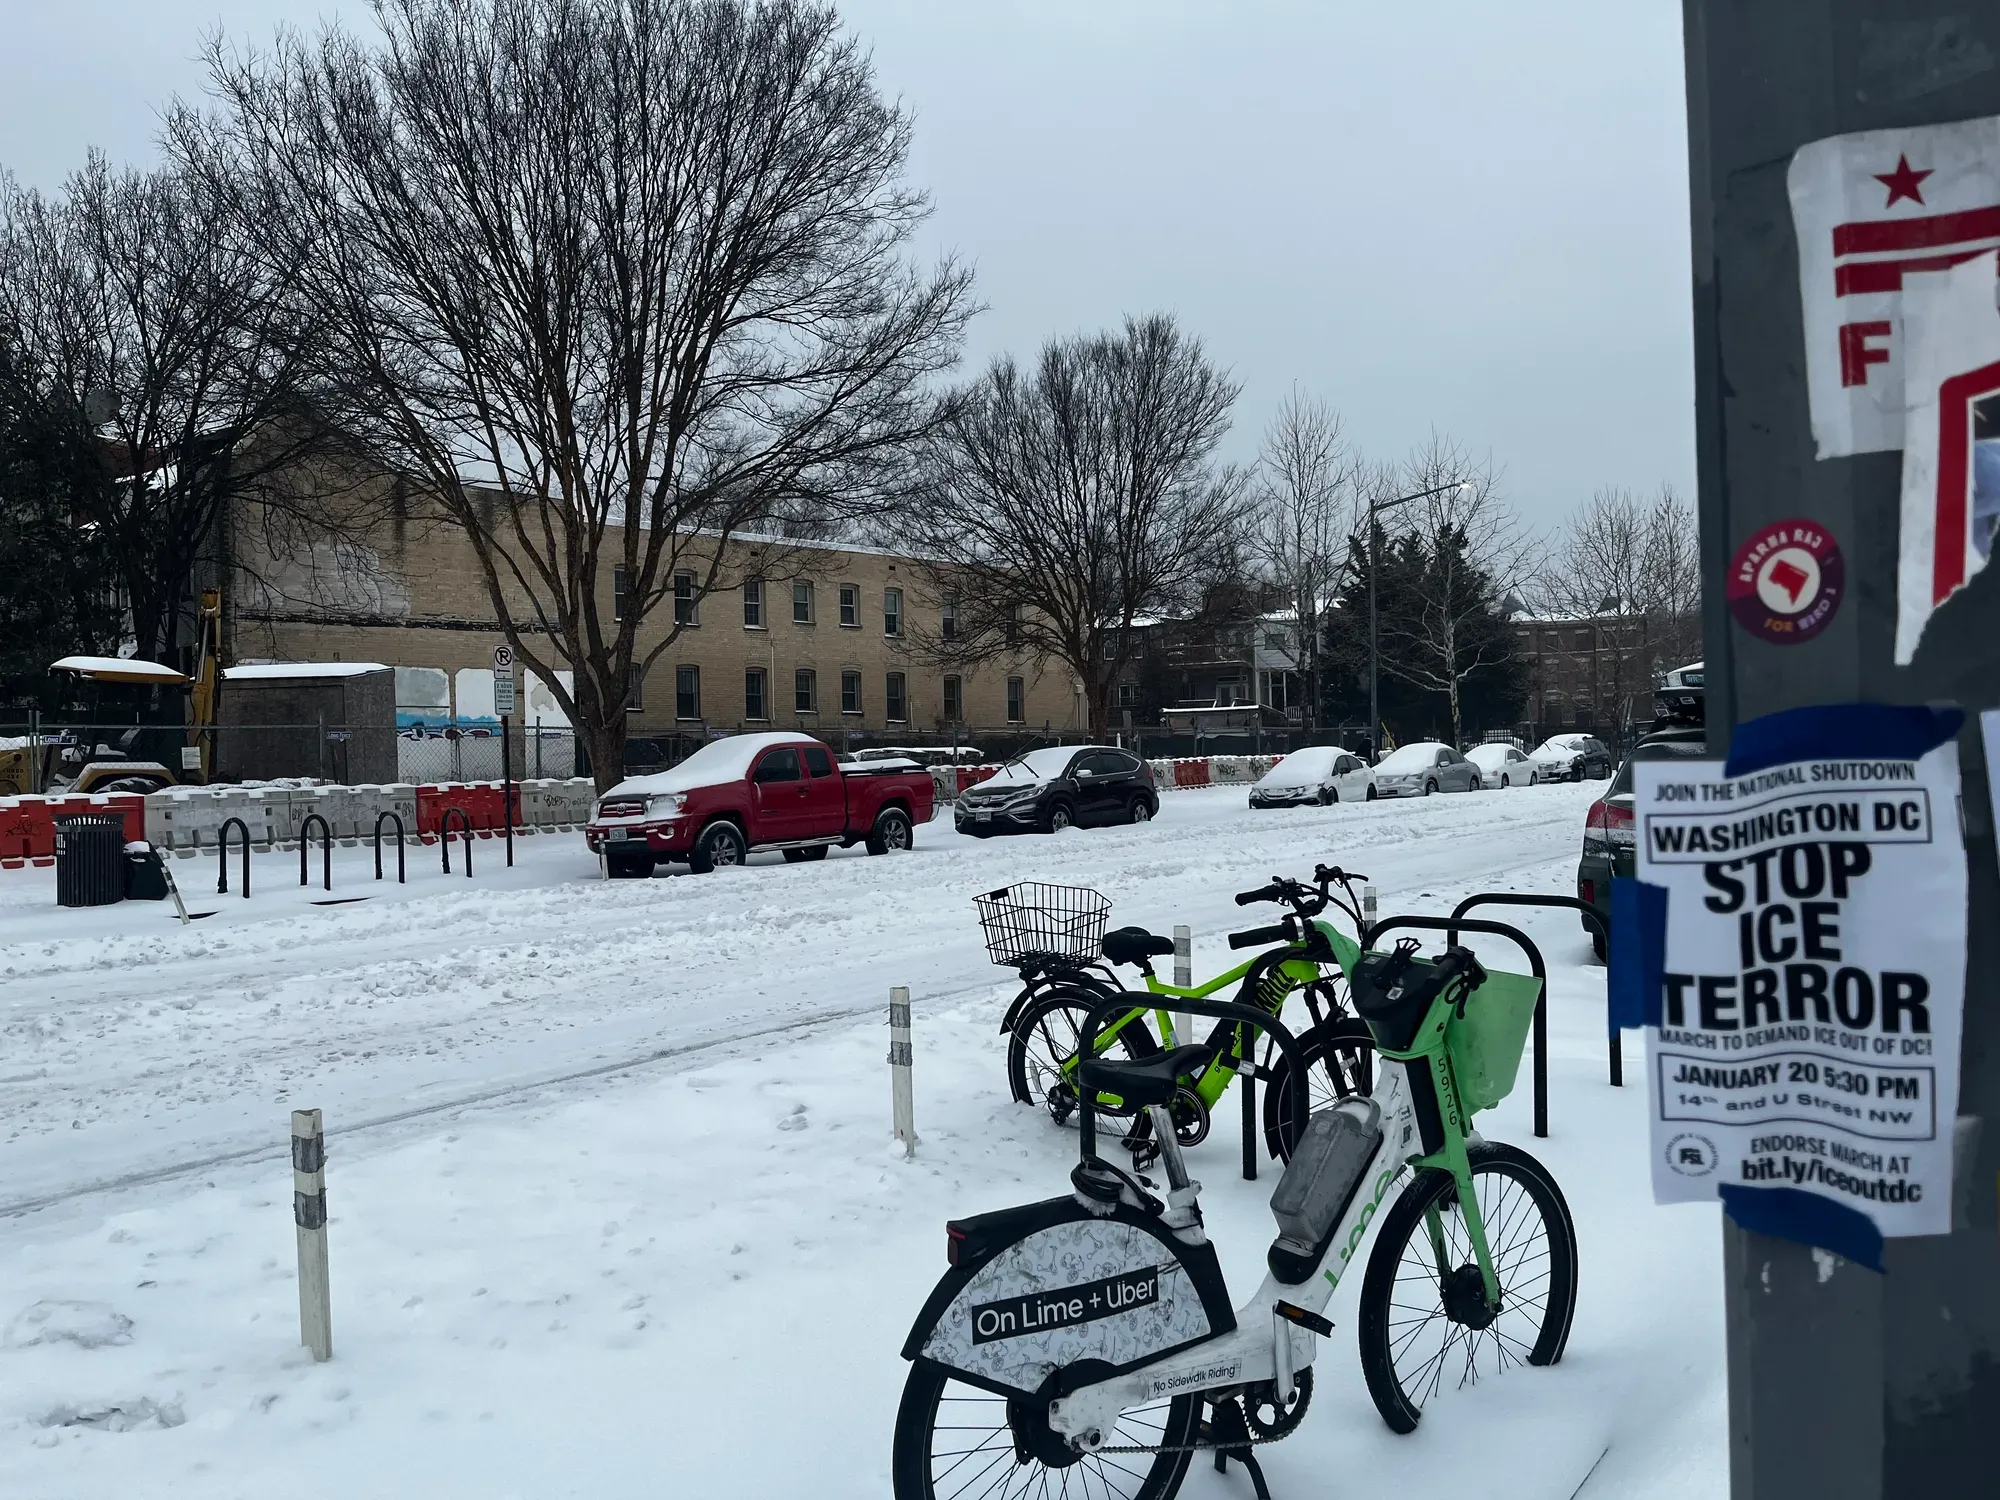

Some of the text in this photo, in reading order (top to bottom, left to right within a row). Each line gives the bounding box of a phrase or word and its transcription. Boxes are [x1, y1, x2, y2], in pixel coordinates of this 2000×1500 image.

[1793, 528, 1823, 549] RAJ
[1654, 762, 1916, 802] JOIN THE NATIONAL SHUTDOWN
[1653, 801, 1921, 853] WASHINGTON DC
[1703, 842, 1873, 914] STOP
[1739, 902, 1842, 970] ICE
[1663, 964, 1931, 1034] TERROR
[1658, 1025, 1932, 1057] MARCH TO DEMAND ICE OUT OF DC!
[1437, 1057, 1458, 1126] 5926
[1672, 1061, 1920, 1100] JANUARY 20 5:30 PM
[1678, 1092, 1913, 1125] 14th and U Street NW
[1751, 1135, 1912, 1174] ENDORSE MARCH AT
[1741, 1155, 1923, 1204] bit.ly/iceoutdc
[976, 1277, 1157, 1337] On Lime + Uber
[1153, 1366, 1236, 1393] No Sidewalk Riding
